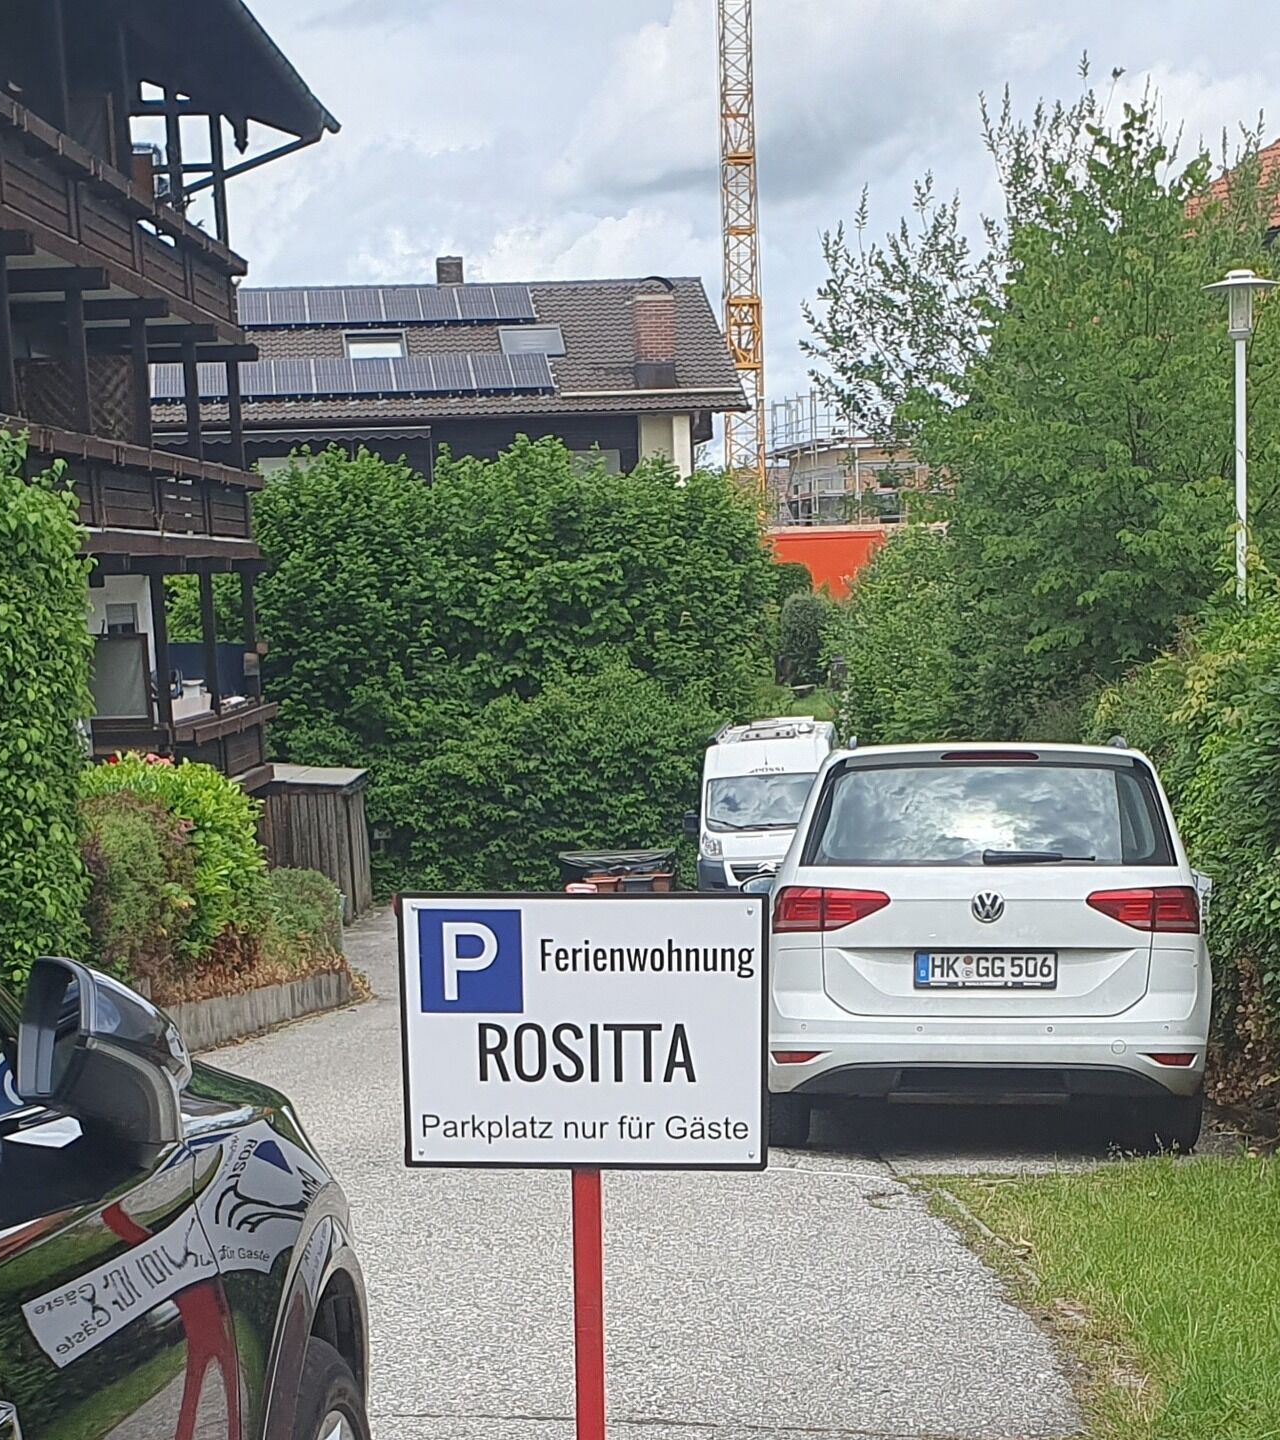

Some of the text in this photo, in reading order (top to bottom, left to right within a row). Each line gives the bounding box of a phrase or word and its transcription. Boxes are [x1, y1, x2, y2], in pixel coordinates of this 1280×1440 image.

[442, 921, 499, 1001] P
[539, 938, 755, 979] Ferienwohnung
[930, 956, 1052, 978] HK GG 506
[477, 1022, 697, 1083] ROSITTA
[421, 1113, 750, 1144] Parkplatz nur für Gäste
